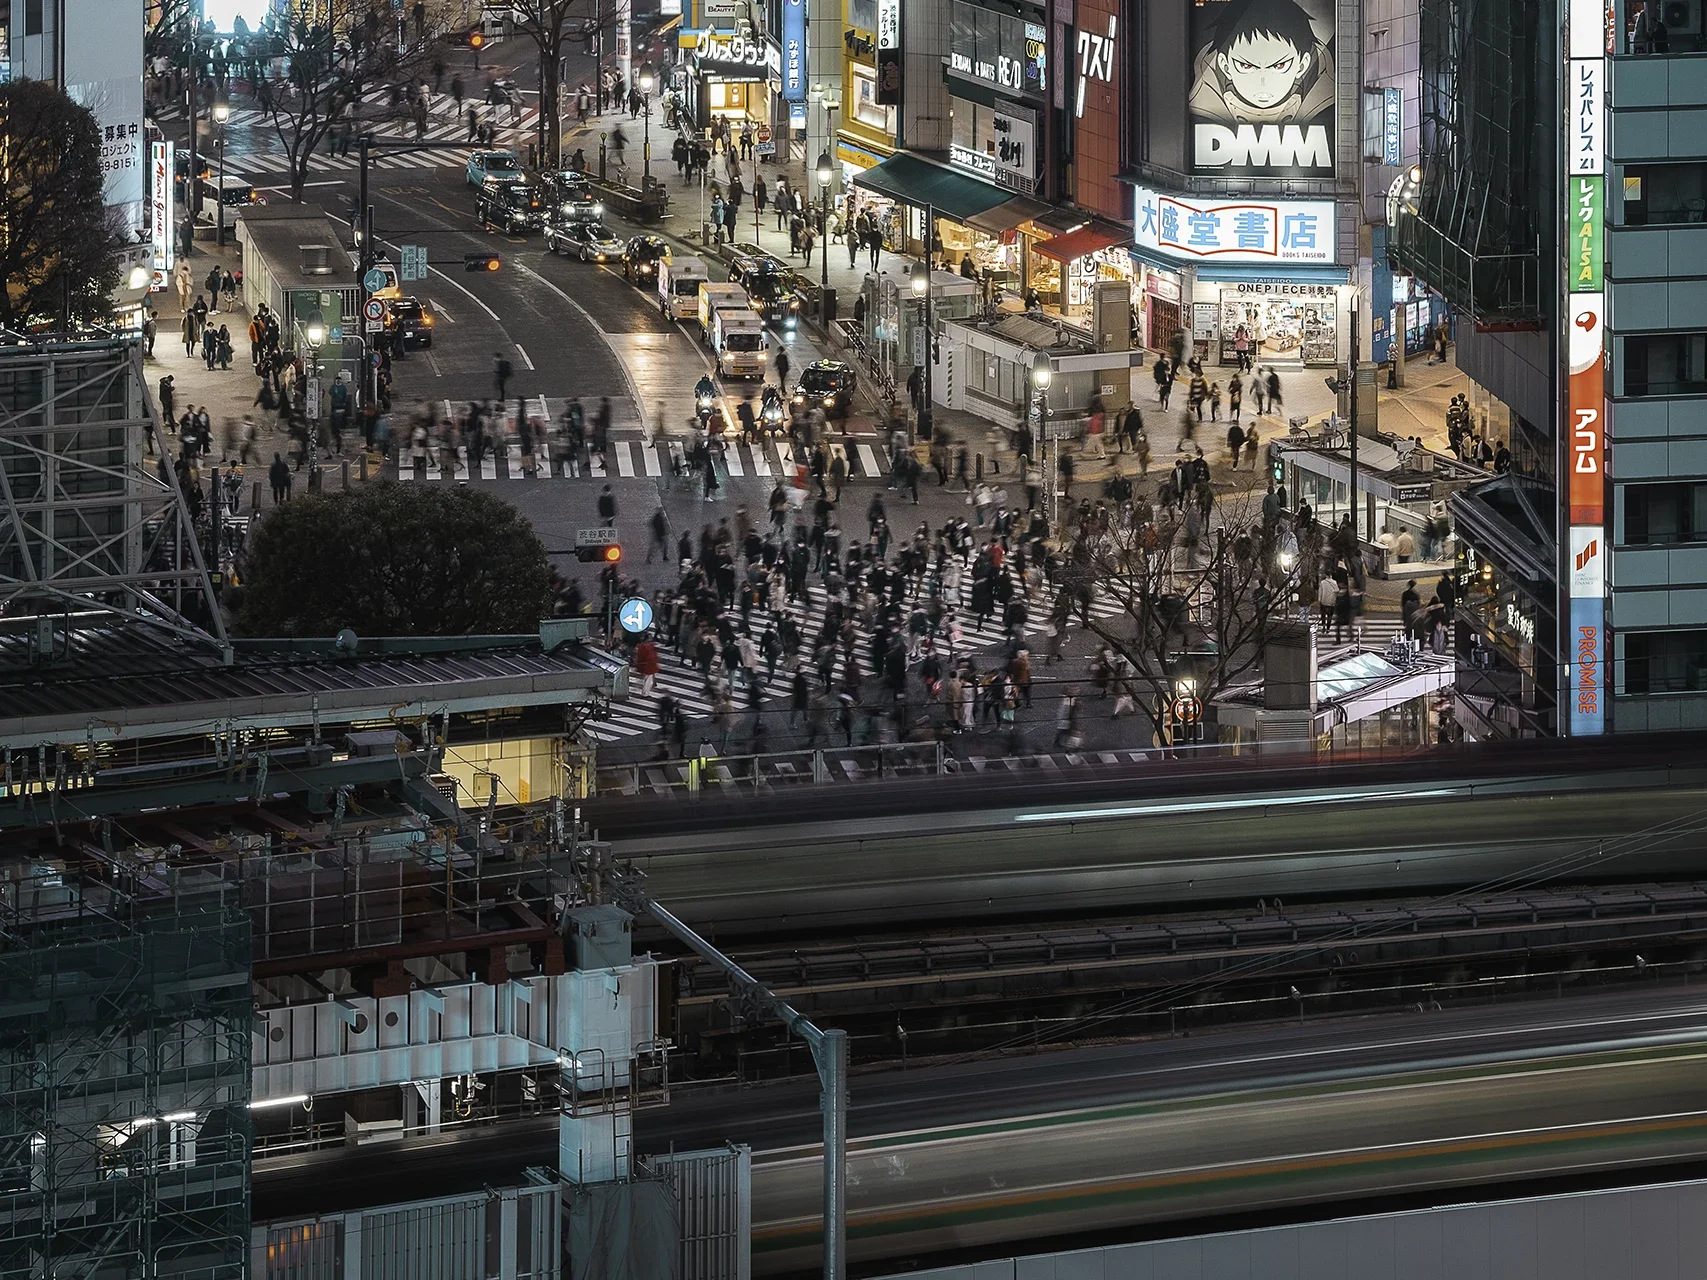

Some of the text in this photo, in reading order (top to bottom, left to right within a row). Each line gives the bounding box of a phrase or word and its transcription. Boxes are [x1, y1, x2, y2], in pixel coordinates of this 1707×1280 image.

[788, 40, 799, 88] みずほ銀行
[1077, 16, 1117, 83] クスリ
[101, 123, 138, 141] 募集中
[1195, 123, 1331, 167] DMM
[1142, 199, 1319, 249] 大盛堂書店
[1575, 408, 1598, 473] アコム
[579, 530, 616, 538] 渋谷駅前
[1578, 626, 1598, 714] PROMISE
